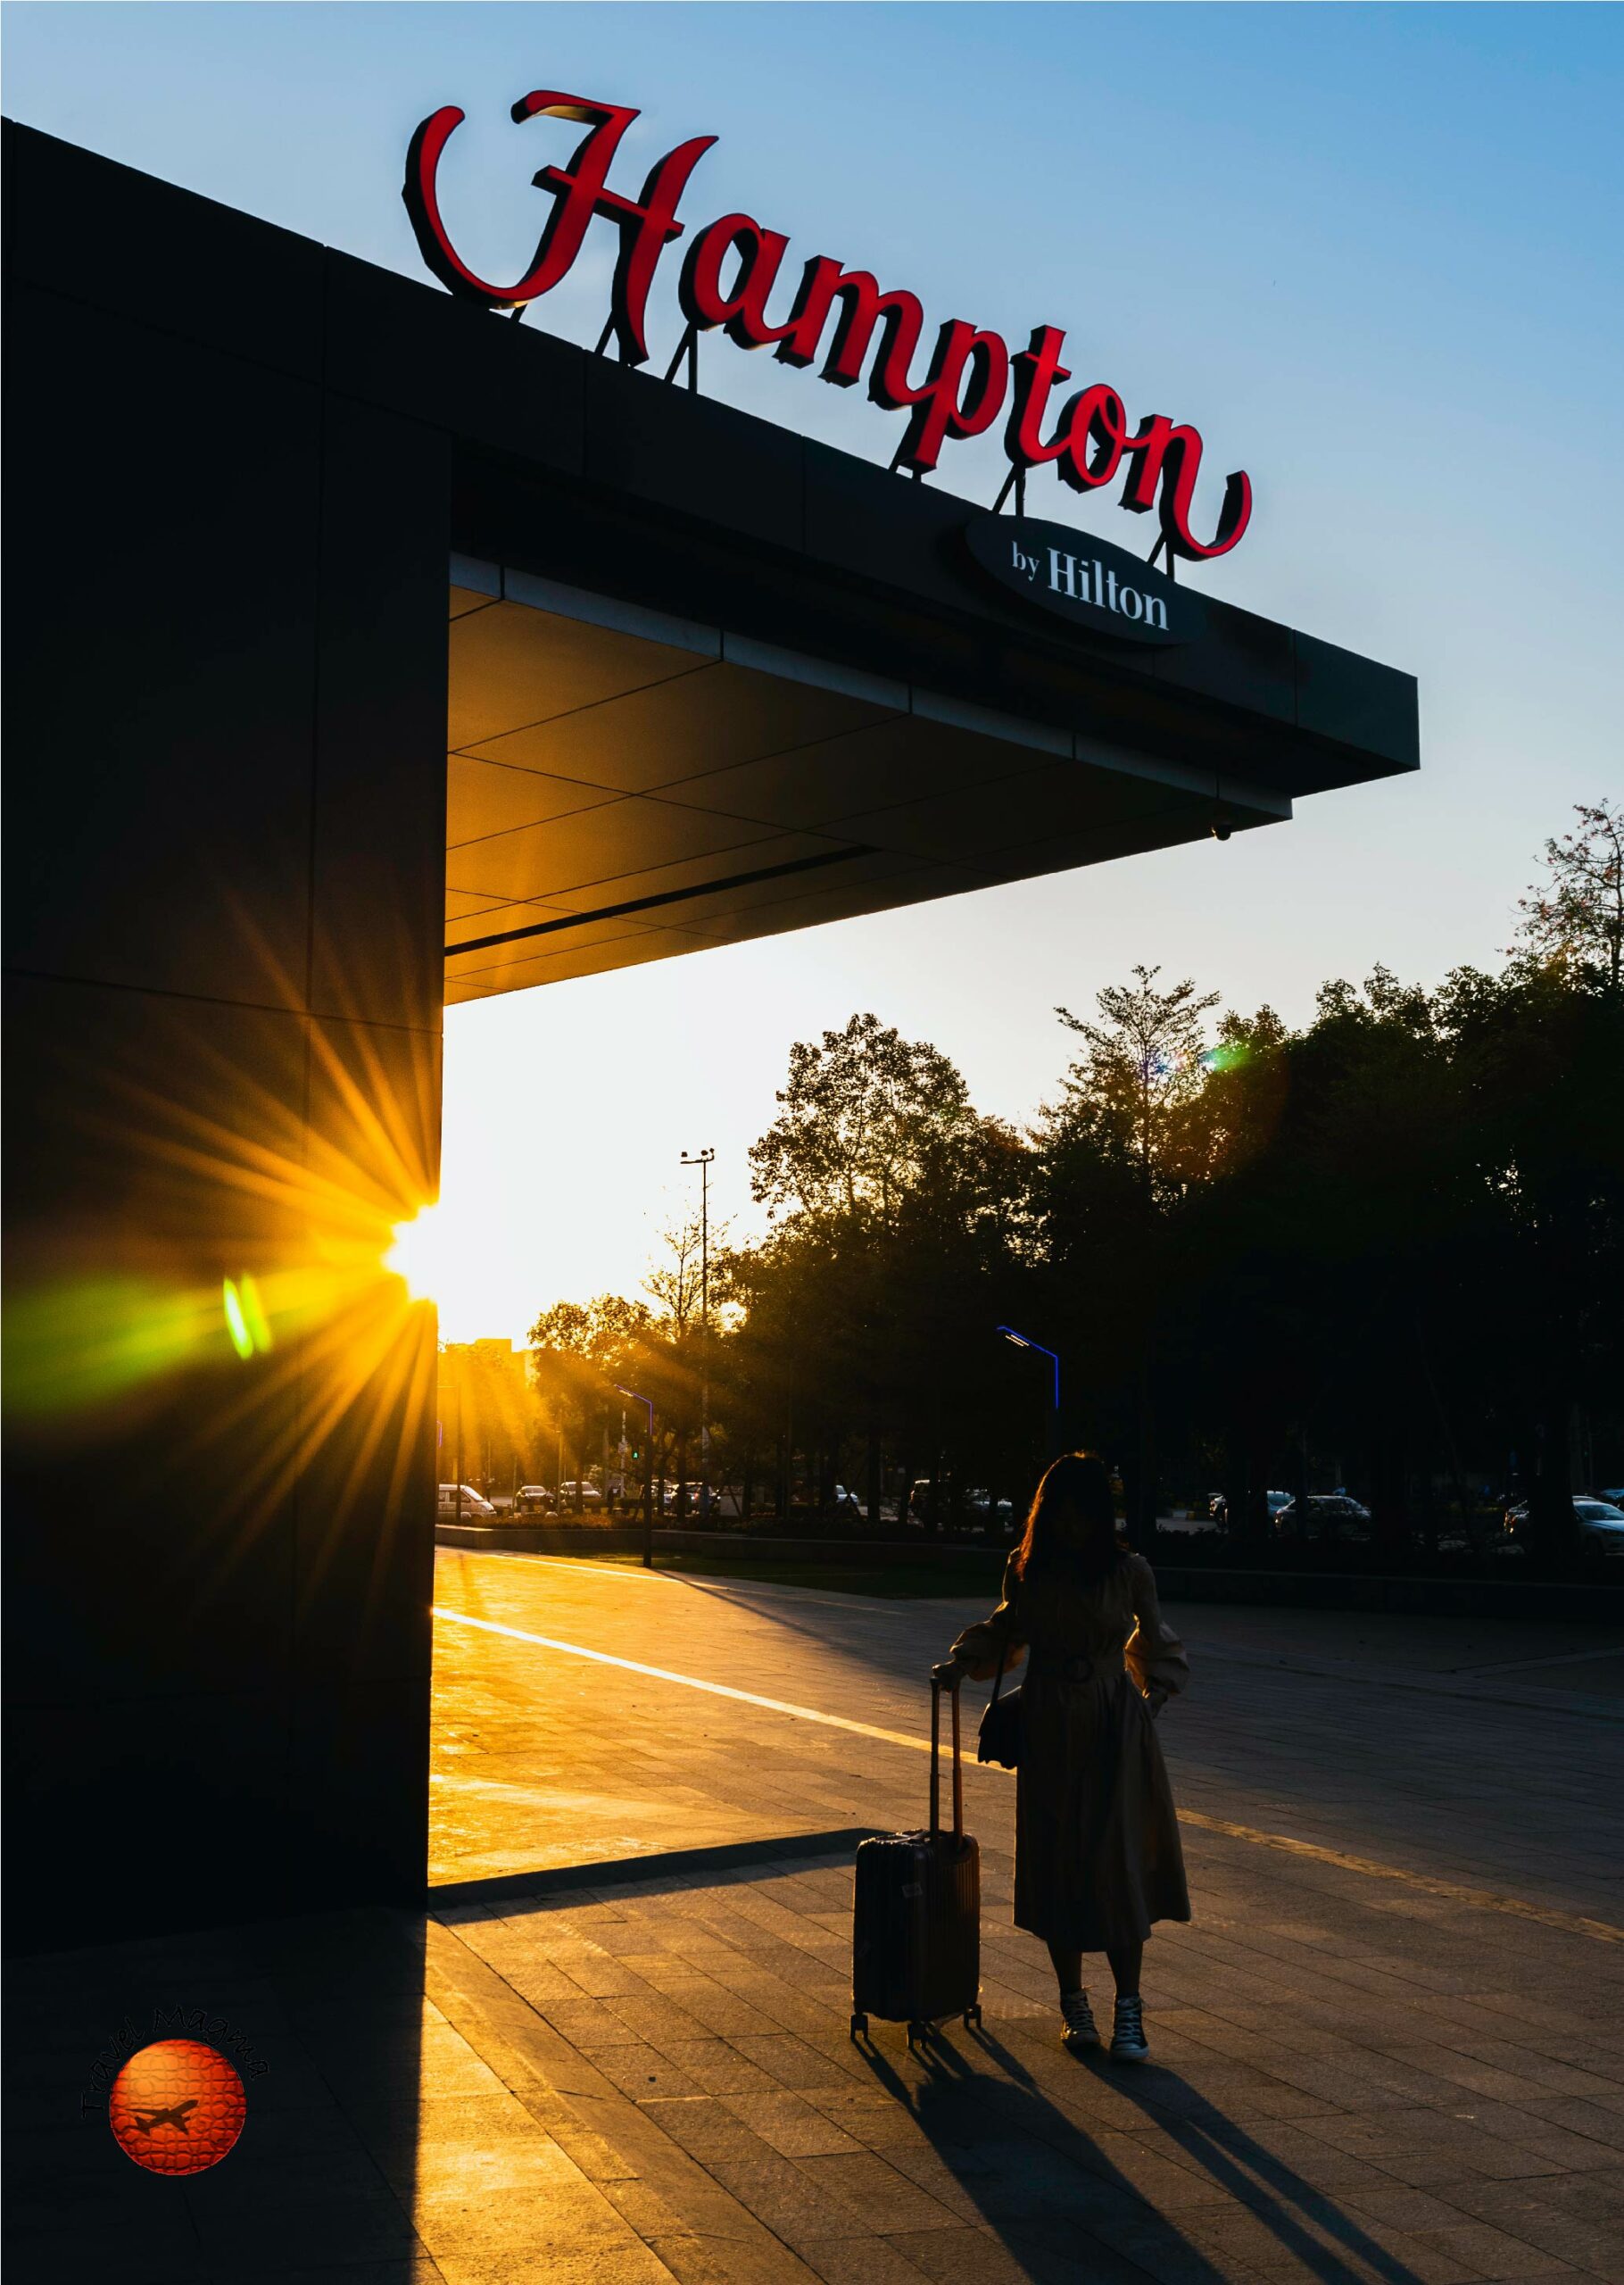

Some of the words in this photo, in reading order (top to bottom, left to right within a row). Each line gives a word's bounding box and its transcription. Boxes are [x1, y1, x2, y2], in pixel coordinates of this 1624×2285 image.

[402, 89, 1252, 561] Hampton
[1011, 541, 1040, 581] by
[1047, 547, 1170, 631] Hilton
